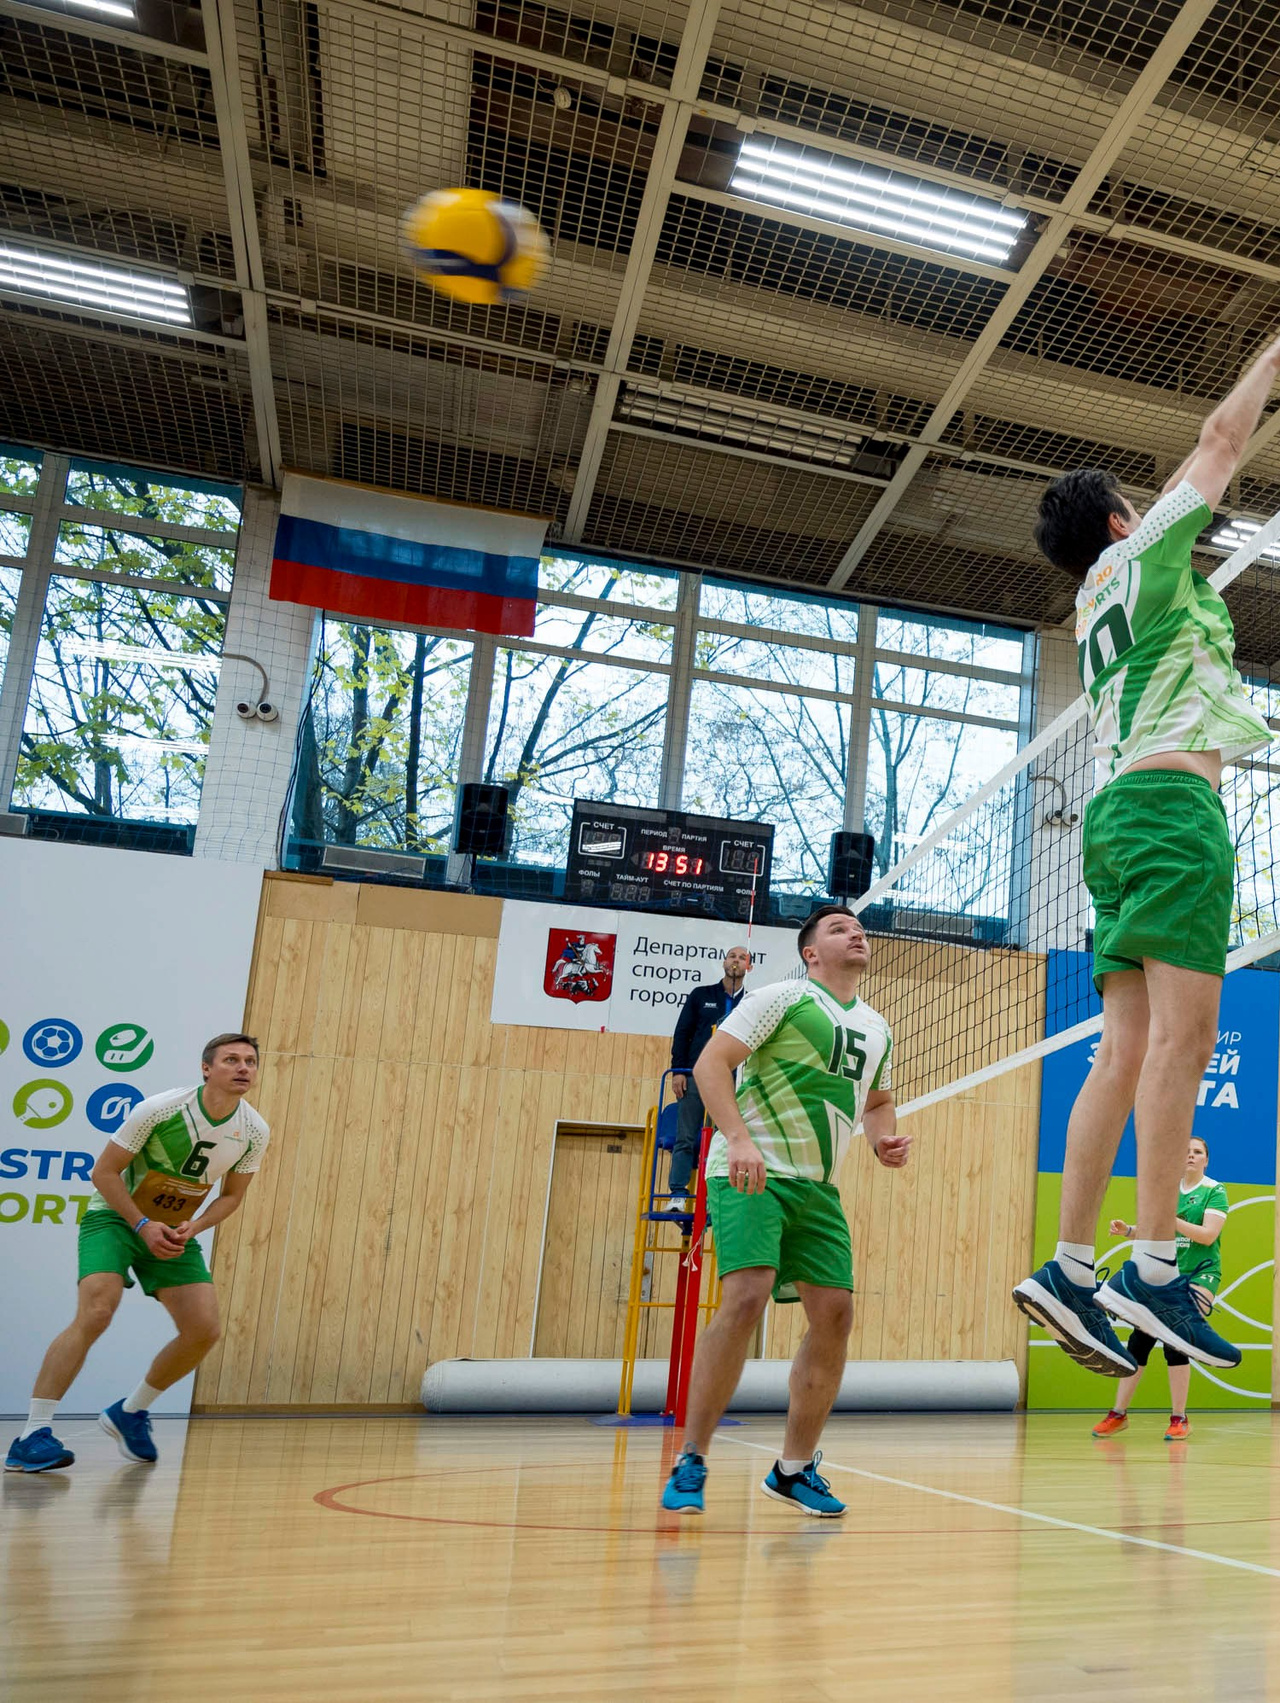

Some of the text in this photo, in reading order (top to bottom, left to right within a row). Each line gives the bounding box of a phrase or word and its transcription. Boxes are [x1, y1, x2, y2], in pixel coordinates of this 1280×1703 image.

[593, 821, 615, 830] СЧЕТ
[641, 829, 668, 838] ПЕРИОД
[681, 834, 708, 842] ПАРТИЯ
[662, 845, 686, 853] ВРЕМЯ
[733, 840, 755, 848] СЧЕТ
[578, 869, 601, 878] ФОЛЫ
[616, 873, 649, 884] ТАЙМ-АУТ
[663, 879, 681, 887] СЧЕТ
[692, 882, 725, 892] ПАРТИЯМ
[633, 936, 767, 965] Департамнт
[632, 964, 702, 983] спорта
[630, 988, 688, 1006] город
[1216, 1030, 1242, 1045] ИР
[828, 1024, 867, 1082] 15
[180, 1140, 218, 1177] 6
[152, 1193, 187, 1212] 433
